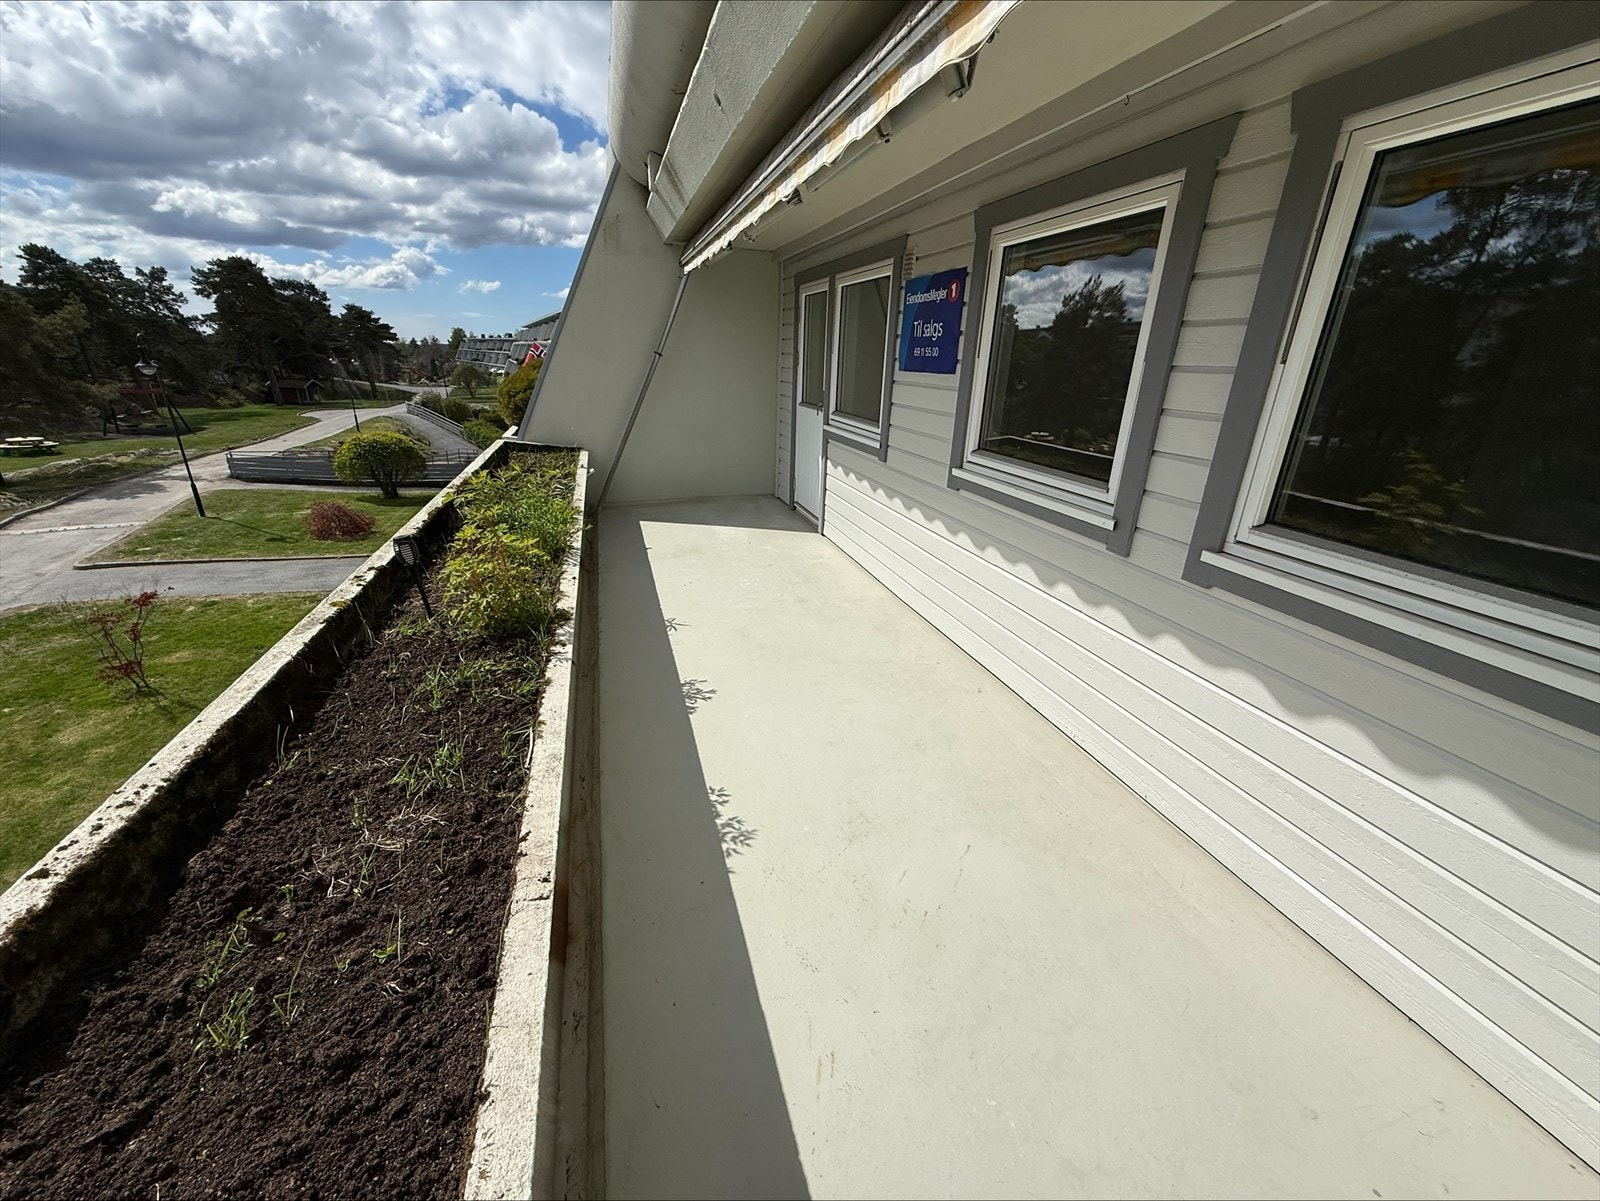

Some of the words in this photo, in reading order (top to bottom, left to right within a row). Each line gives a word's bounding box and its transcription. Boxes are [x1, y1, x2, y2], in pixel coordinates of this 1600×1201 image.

[913, 319, 923, 338] Til
[923, 318, 943, 341] salgs
[914, 347, 921, 357] 69
[921, 347, 925, 356] 11
[925, 347, 932, 357] 55
[932, 347, 939, 357] 00
